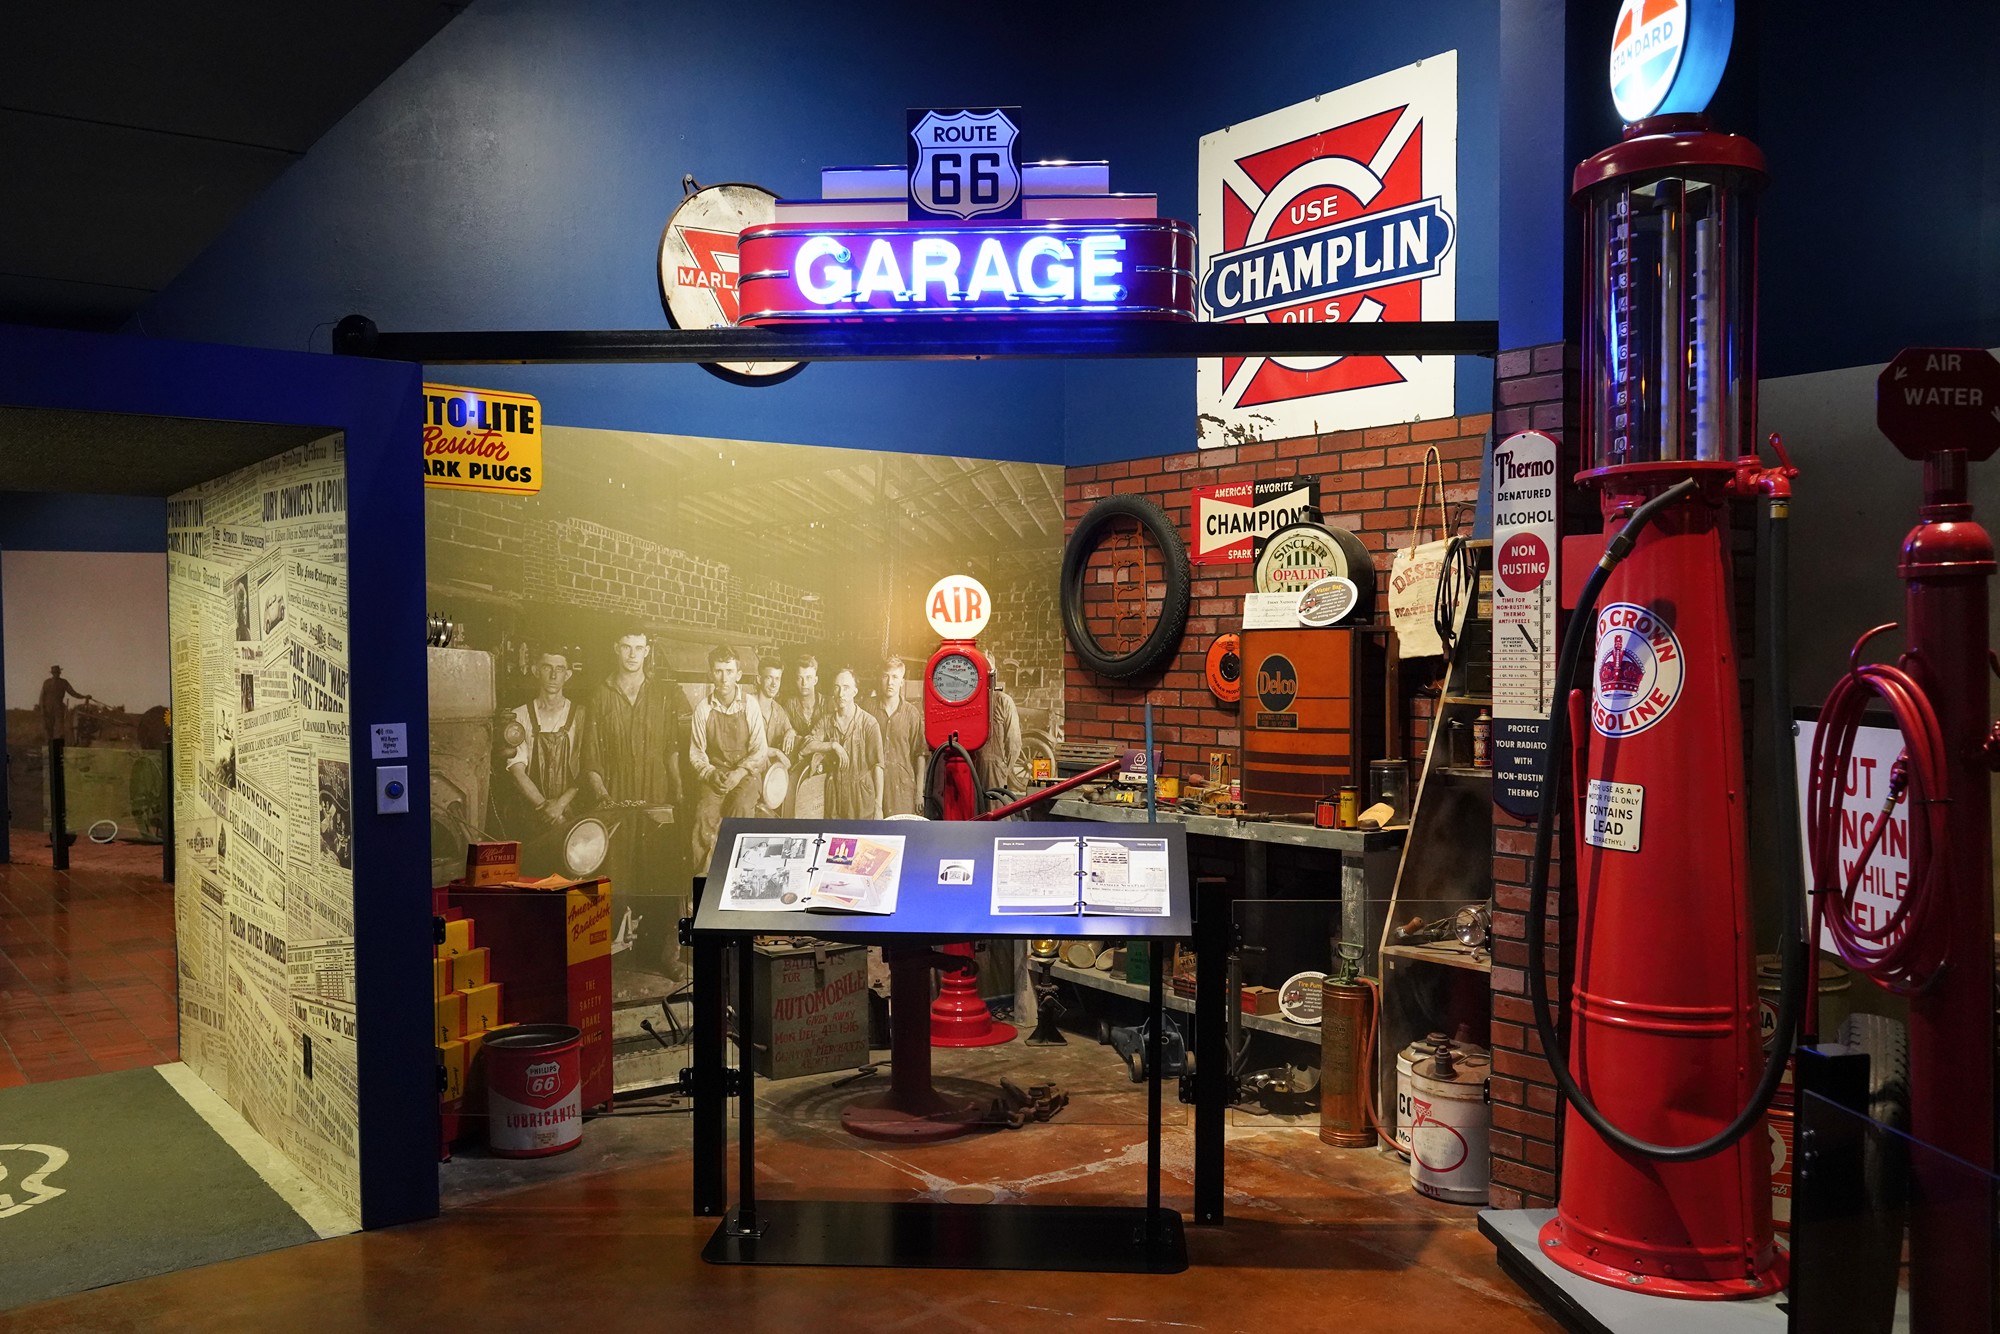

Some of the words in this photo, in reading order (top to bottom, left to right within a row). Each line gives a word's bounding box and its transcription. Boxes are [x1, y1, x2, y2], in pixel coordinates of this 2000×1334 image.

[1614, 21, 1673, 77] STANDARD
[934, 125, 997, 143] ROUTE
[931, 153, 999, 204] 66
[1291, 195, 1338, 225] USE
[794, 234, 1128, 304] GARAGE
[1216, 215, 1429, 309] CHAMPLIN
[1925, 354, 1962, 372] AIR
[1904, 388, 1983, 406] WATER
[469, 462, 532, 483] PLUGS
[1495, 450, 1554, 489] Thermo
[1214, 485, 1252, 498] AMERICA'S
[1255, 482, 1293, 495] FAVORITE
[1497, 488, 1552, 502] DENATURED
[262, 491, 279, 522] JURY
[280, 483, 313, 519] CONVICTS
[1206, 507, 1302, 536] CHAMPION
[1496, 510, 1554, 526] ALCOHOL
[1228, 549, 1252, 559] SPARK
[1273, 539, 1328, 562] SINCLAIR
[1511, 545, 1536, 556] NON
[1502, 562, 1546, 574] RUSTING
[931, 587, 982, 623] AIR
[1610, 610, 1676, 664] CROWN
[307, 650, 326, 687] RADIO
[293, 672, 312, 710] STIRS
[1259, 671, 1296, 695] Delco
[1592, 687, 1670, 730] ASOLINE
[1508, 725, 1539, 733] PROTECT
[1496, 740, 1515, 749] YOUR
[1514, 757, 1533, 765] WITH
[1507, 788, 1539, 798] THERMO
[1602, 785, 1613, 793] USE
[1603, 795, 1619, 804] FUEL
[1620, 798, 1640, 806] ONLY
[1589, 804, 1633, 820] CONTAINS
[1593, 819, 1624, 836] LEAD
[263, 837, 283, 869] CONTEST
[230, 911, 246, 941] POLISH
[248, 922, 263, 950] CITIES
[264, 931, 287, 965] BOMBED
[585, 979, 596, 991] THE
[782, 972, 801, 983] FOR
[580, 995, 601, 1011] SAFETY
[774, 969, 866, 1021] AUTOMOBILE
[331, 1011, 341, 1033] Star
[581, 1017, 601, 1030] BRAKE
[529, 1064, 558, 1075] PHILLIPS
[532, 1076, 556, 1093] 66
[507, 1104, 576, 1128] LUBRICANTS
[1423, 1183, 1441, 1197] OIL
